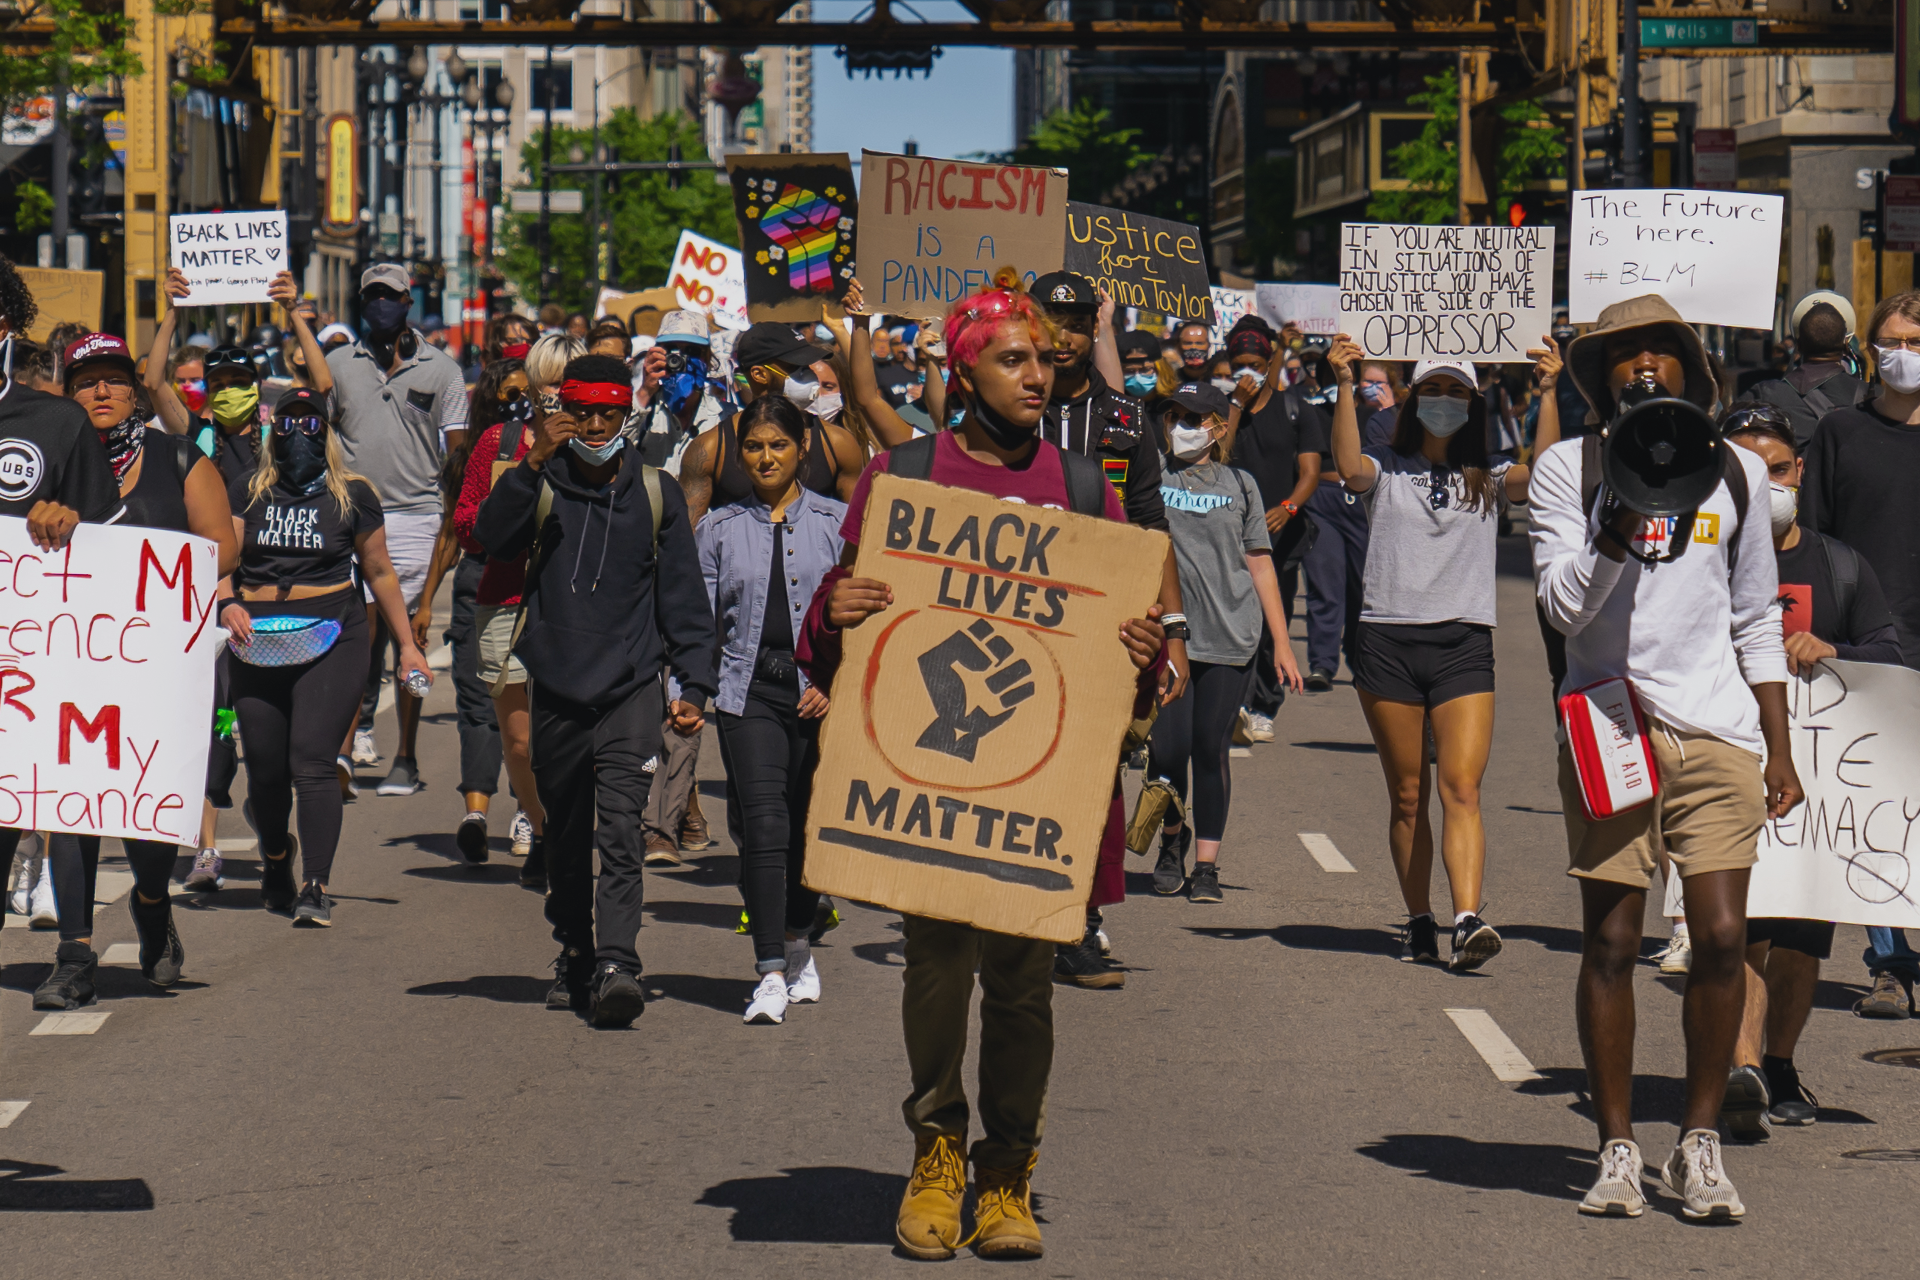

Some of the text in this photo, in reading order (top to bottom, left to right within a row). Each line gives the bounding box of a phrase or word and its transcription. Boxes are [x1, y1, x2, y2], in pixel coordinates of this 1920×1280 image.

[1665, 23, 1707, 39] Wells
[884, 157, 1046, 216] RACISM
[1581, 192, 1765, 221] The Future
[177, 220, 281, 243] BLACK LIVES
[1068, 212, 1200, 264] ustice
[1345, 225, 1546, 250] IF YOU ARE NEUTRAL
[1589, 226, 1609, 246] is
[181, 247, 263, 268] MATTER
[680, 241, 727, 276] NO
[976, 235, 995, 260] A
[1097, 244, 1158, 275] for
[1349, 249, 1536, 272] IN SITUATIONS OF
[227, 276, 248, 287] George
[673, 273, 714, 306] NO
[882, 259, 1037, 304] PANDE
[1340, 271, 1534, 292] INJUSTICE YOU HAVE
[1142, 277, 1213, 319] Taylor
[1213, 291, 1244, 309] ACK
[1340, 291, 1536, 312] CHOSEN THE SIDE OF THE
[90, 339, 121, 351] Town
[1364, 312, 1518, 356] OPPRESSOR
[265, 505, 318, 524] BLACK
[268, 519, 312, 537] LIVES
[257, 529, 323, 549] MATTER
[885, 498, 1060, 576] BLACK
[136, 538, 217, 653] My
[937, 566, 1068, 628] LIVES
[0, 612, 151, 663] ence
[58, 701, 159, 797] My
[1606, 702, 1643, 790] FIRST AID
[1789, 725, 1879, 789] TE
[844, 778, 1074, 866] MATTER.
[1762, 796, 1920, 853] EMACY
